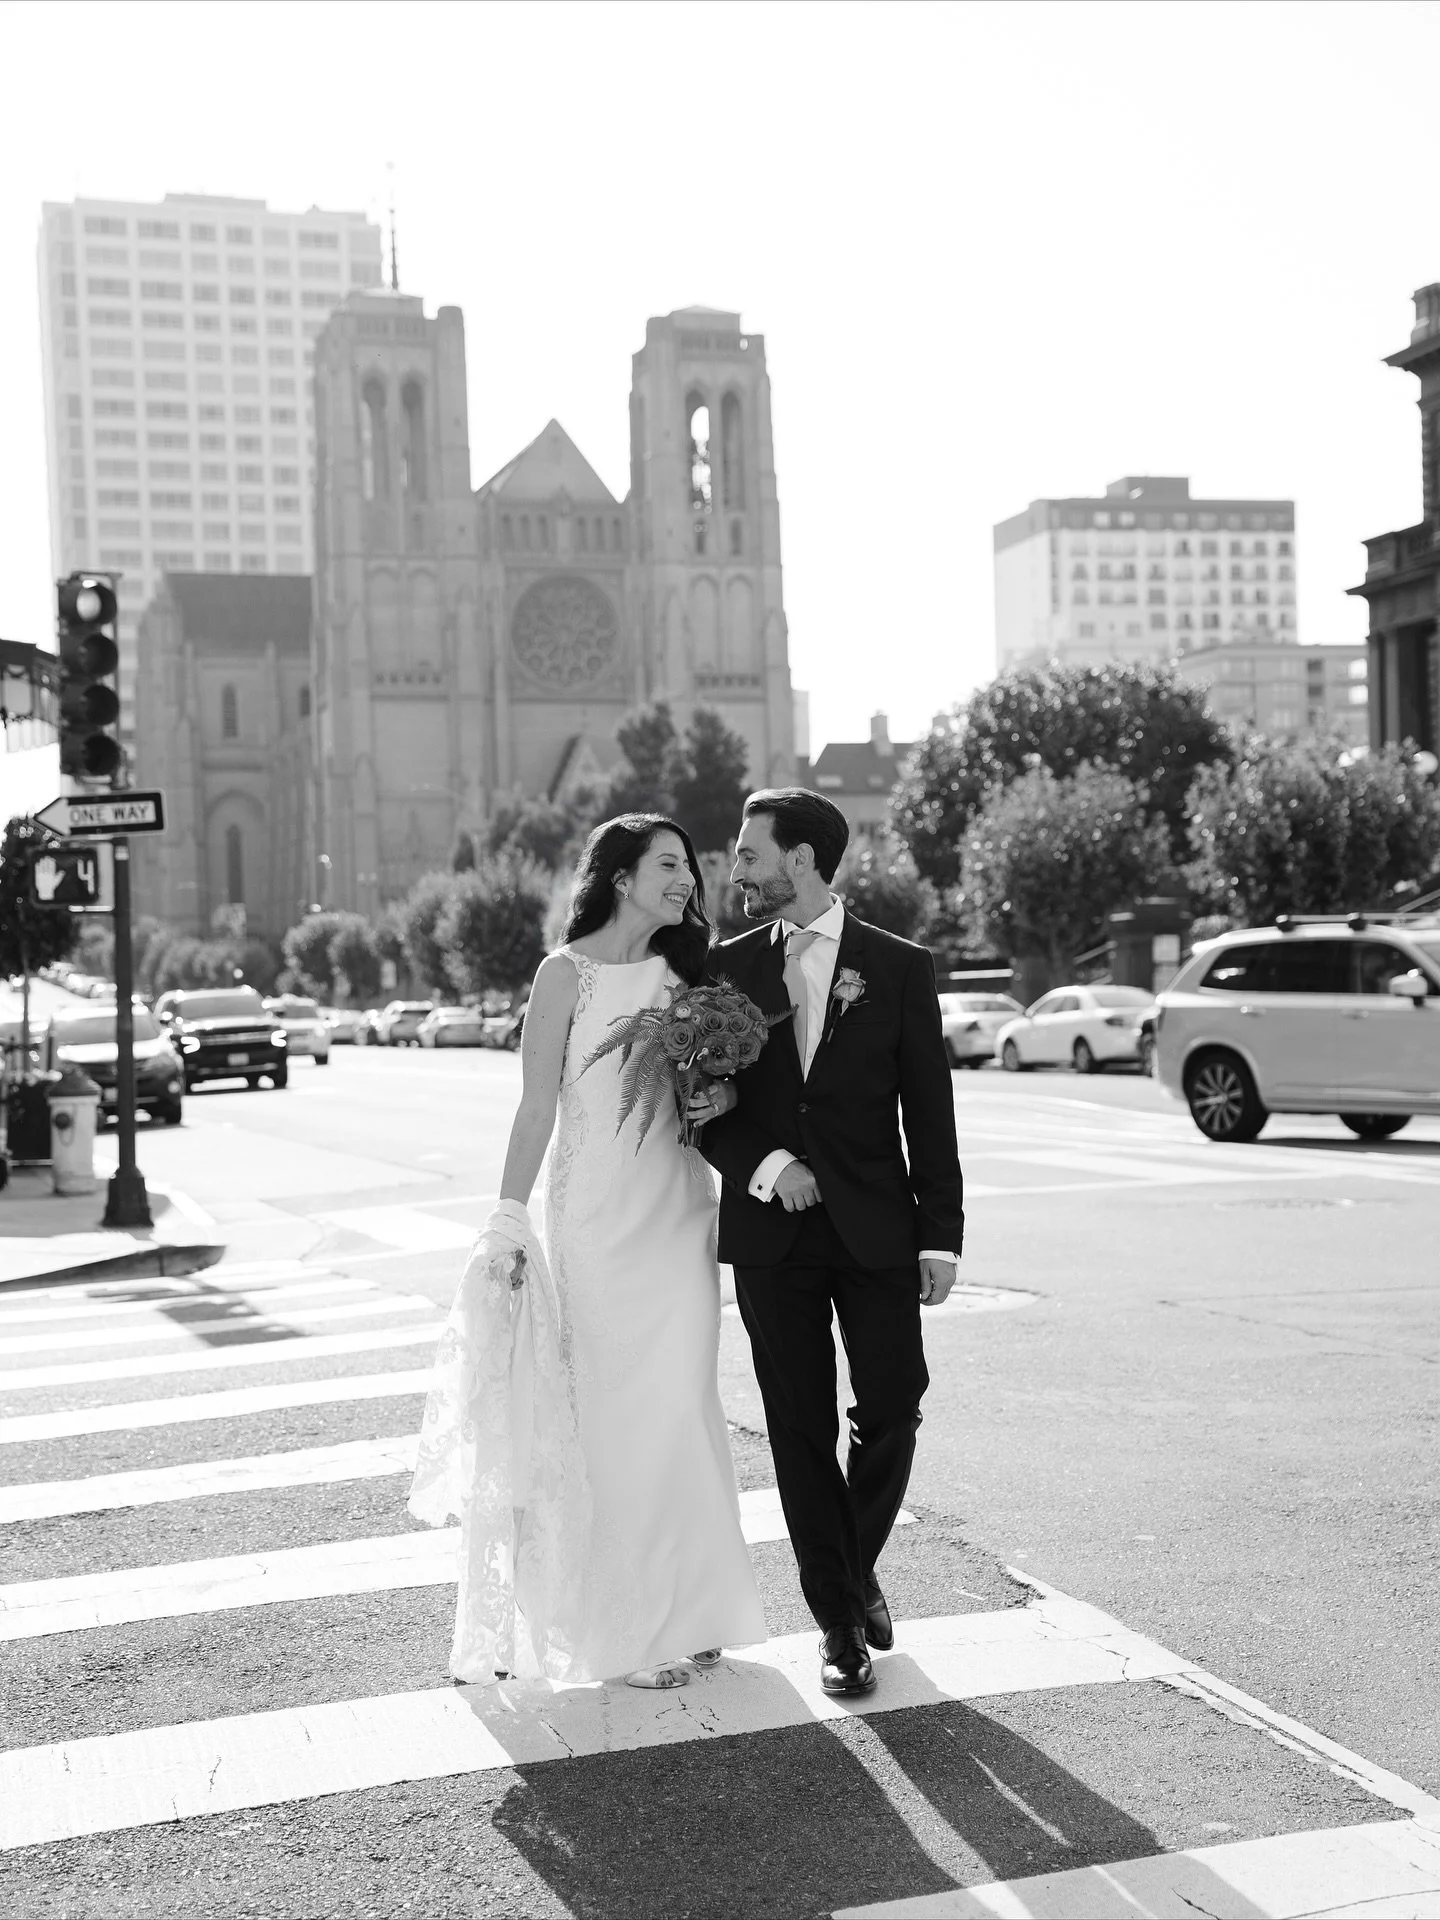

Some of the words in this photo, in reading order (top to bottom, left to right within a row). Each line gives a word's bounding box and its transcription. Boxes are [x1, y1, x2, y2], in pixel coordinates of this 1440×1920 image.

[69, 807, 105, 826] ONE
[112, 804, 149, 821] WAY
[77, 859, 95, 894] 4
